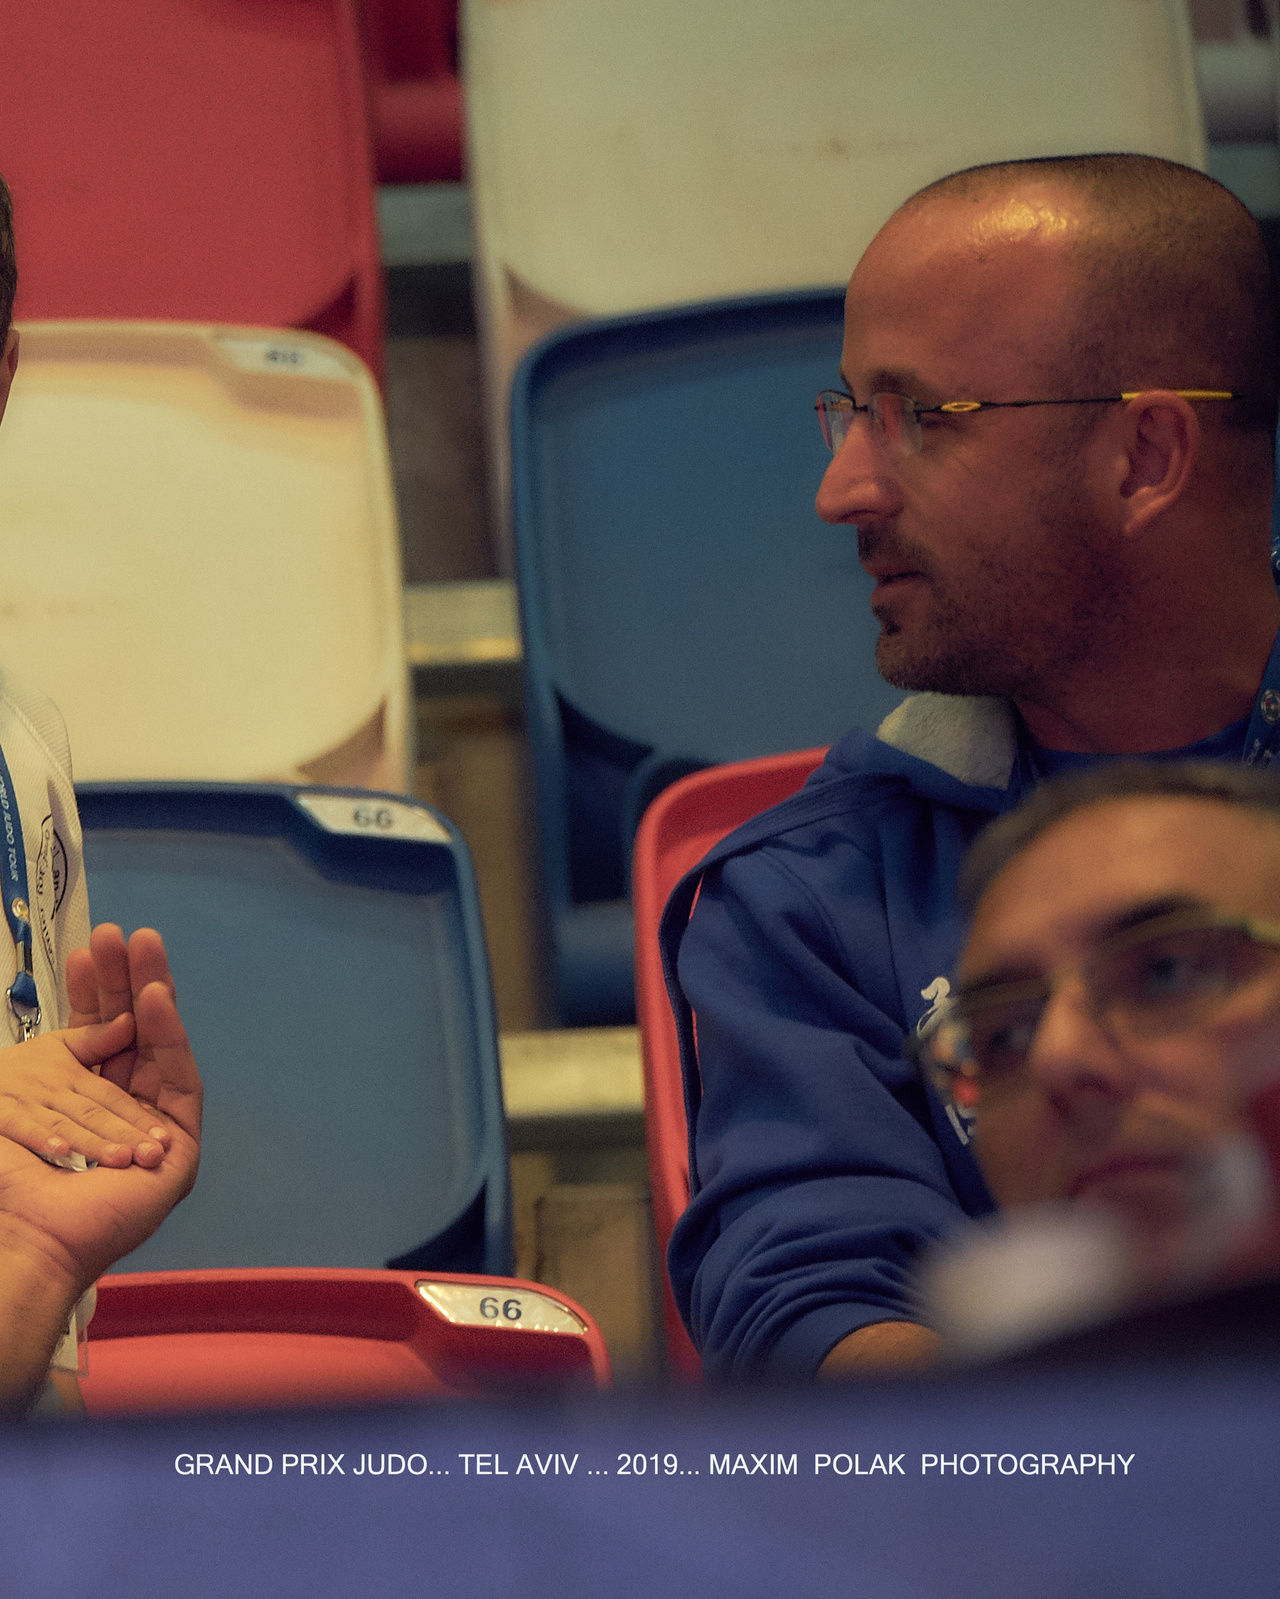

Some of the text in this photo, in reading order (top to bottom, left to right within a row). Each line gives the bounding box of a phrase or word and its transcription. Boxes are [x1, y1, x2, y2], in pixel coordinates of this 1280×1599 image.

[4, 810, 15, 845] JUDO
[8, 847, 19, 882] TOUR
[479, 1297, 522, 1320] 66
